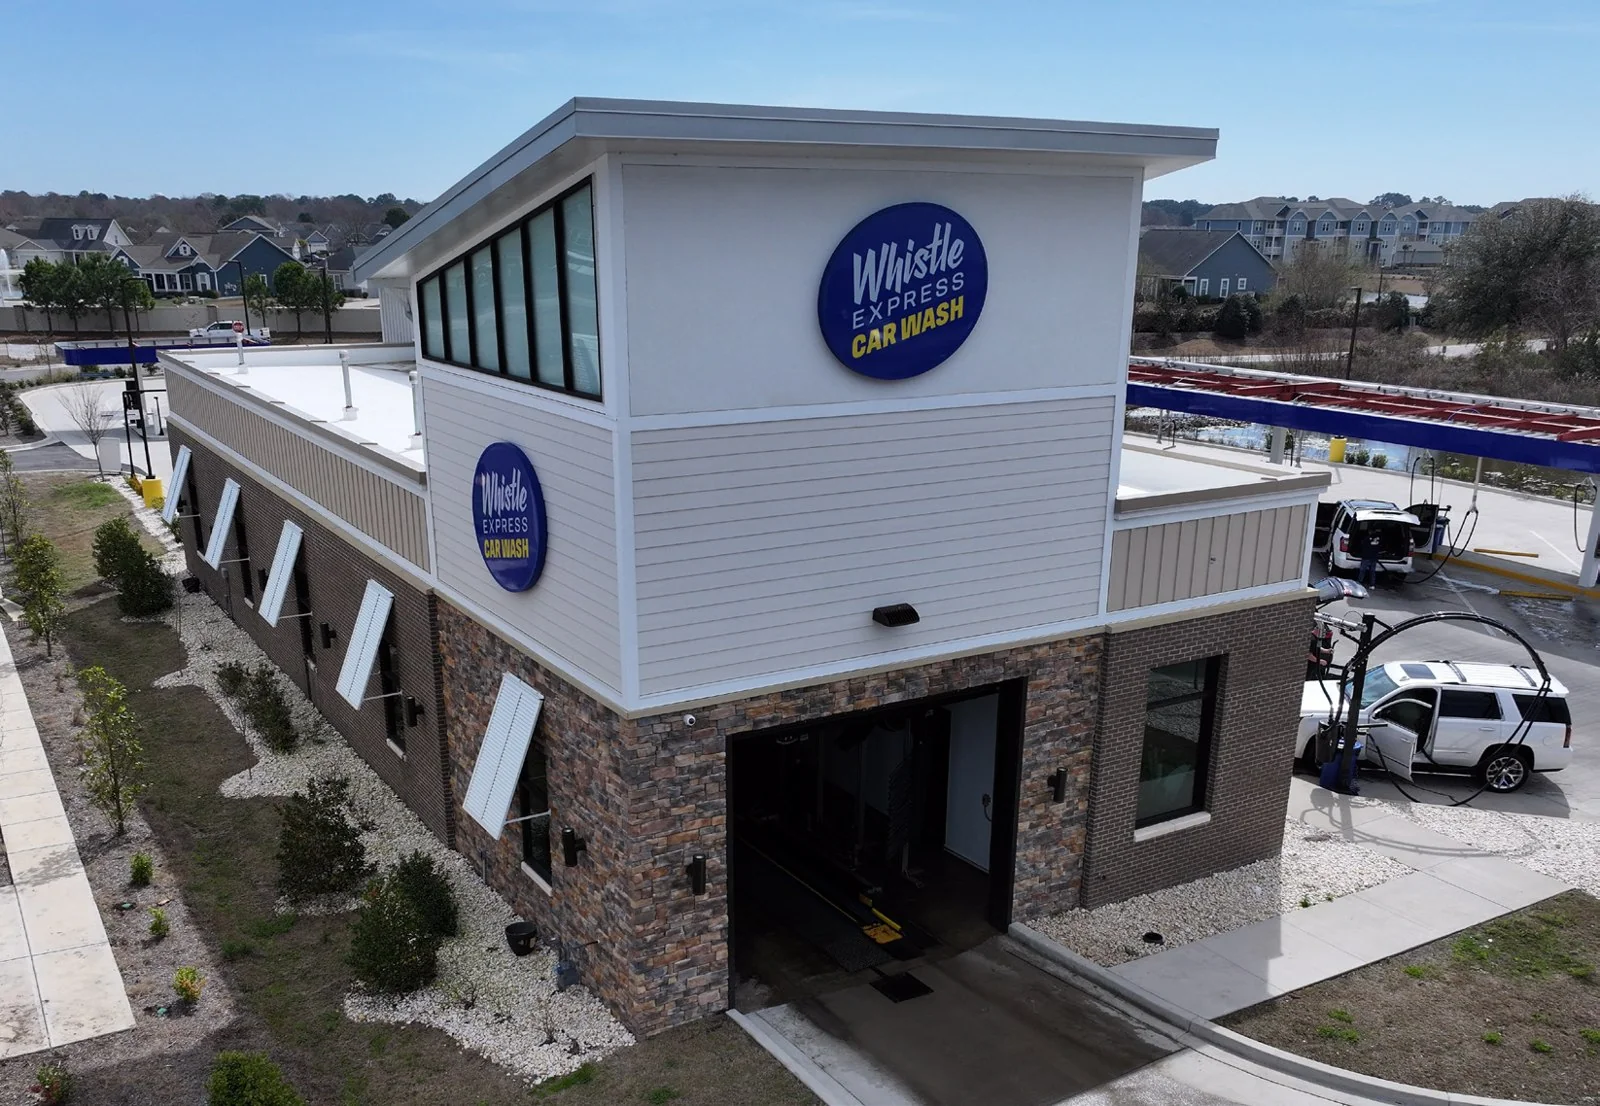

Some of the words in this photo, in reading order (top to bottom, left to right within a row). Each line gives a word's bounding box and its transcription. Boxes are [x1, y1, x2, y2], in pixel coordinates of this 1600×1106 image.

[853, 222, 964, 305] Whistle
[852, 322, 896, 358] CAR
[901, 295, 964, 340] WASH
[853, 272, 964, 329] EXPRESS
[481, 467, 527, 517] Whistle
[483, 517, 528, 534] EXPRESS
[484, 539, 501, 558] CAR
[501, 538, 528, 558] WASH
